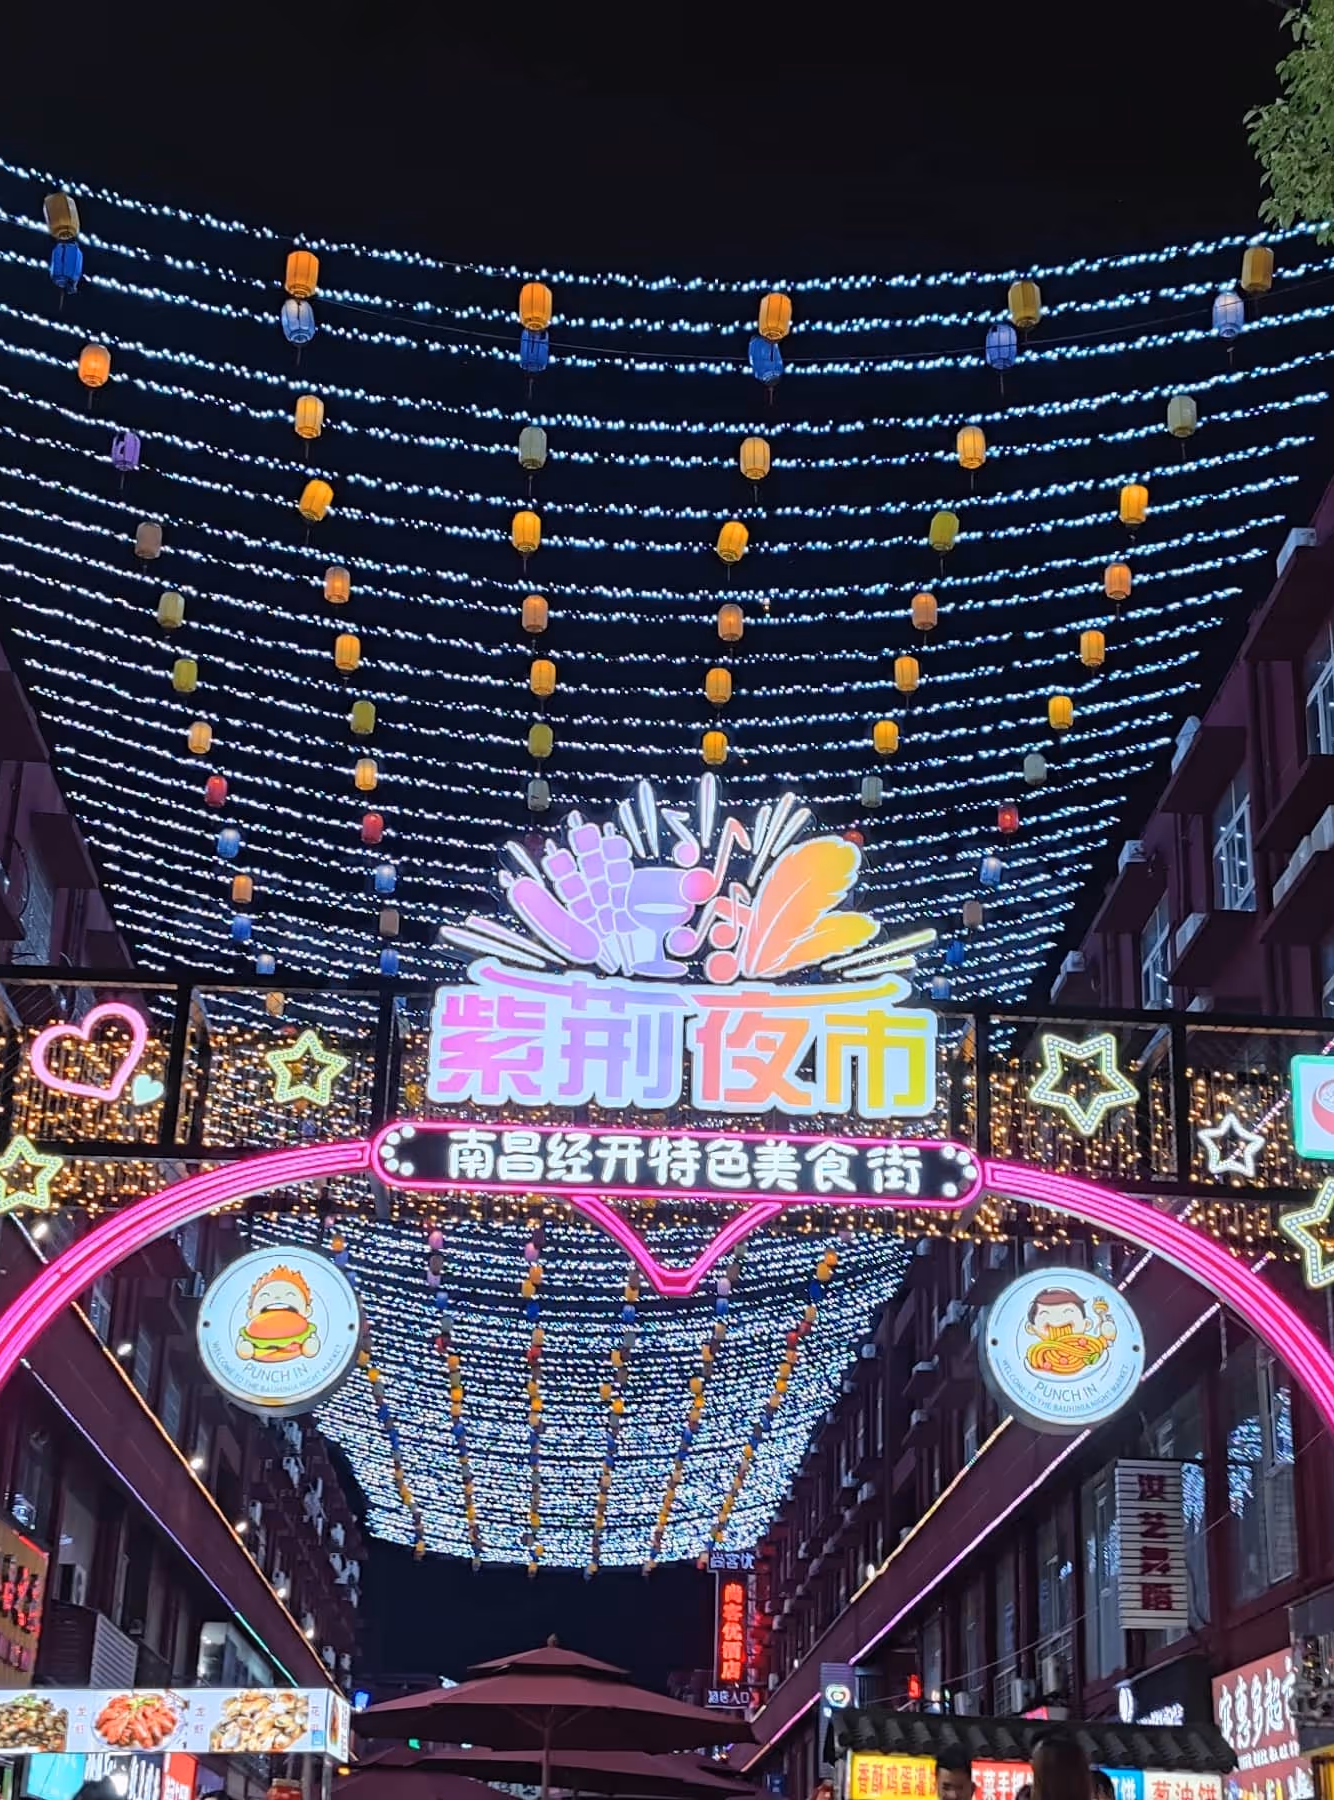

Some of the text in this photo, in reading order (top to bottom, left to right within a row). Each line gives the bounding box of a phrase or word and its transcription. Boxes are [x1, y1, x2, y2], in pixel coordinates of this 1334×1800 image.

[438, 964, 928, 1110] 紫荆夜市
[446, 1127, 923, 1196] 南昌经开特色美食街
[243, 1362, 309, 1383] PUNCH IN
[1034, 1380, 1098, 1402] PUNCH IN
[720, 1583, 744, 1681] 尚客优酒店
